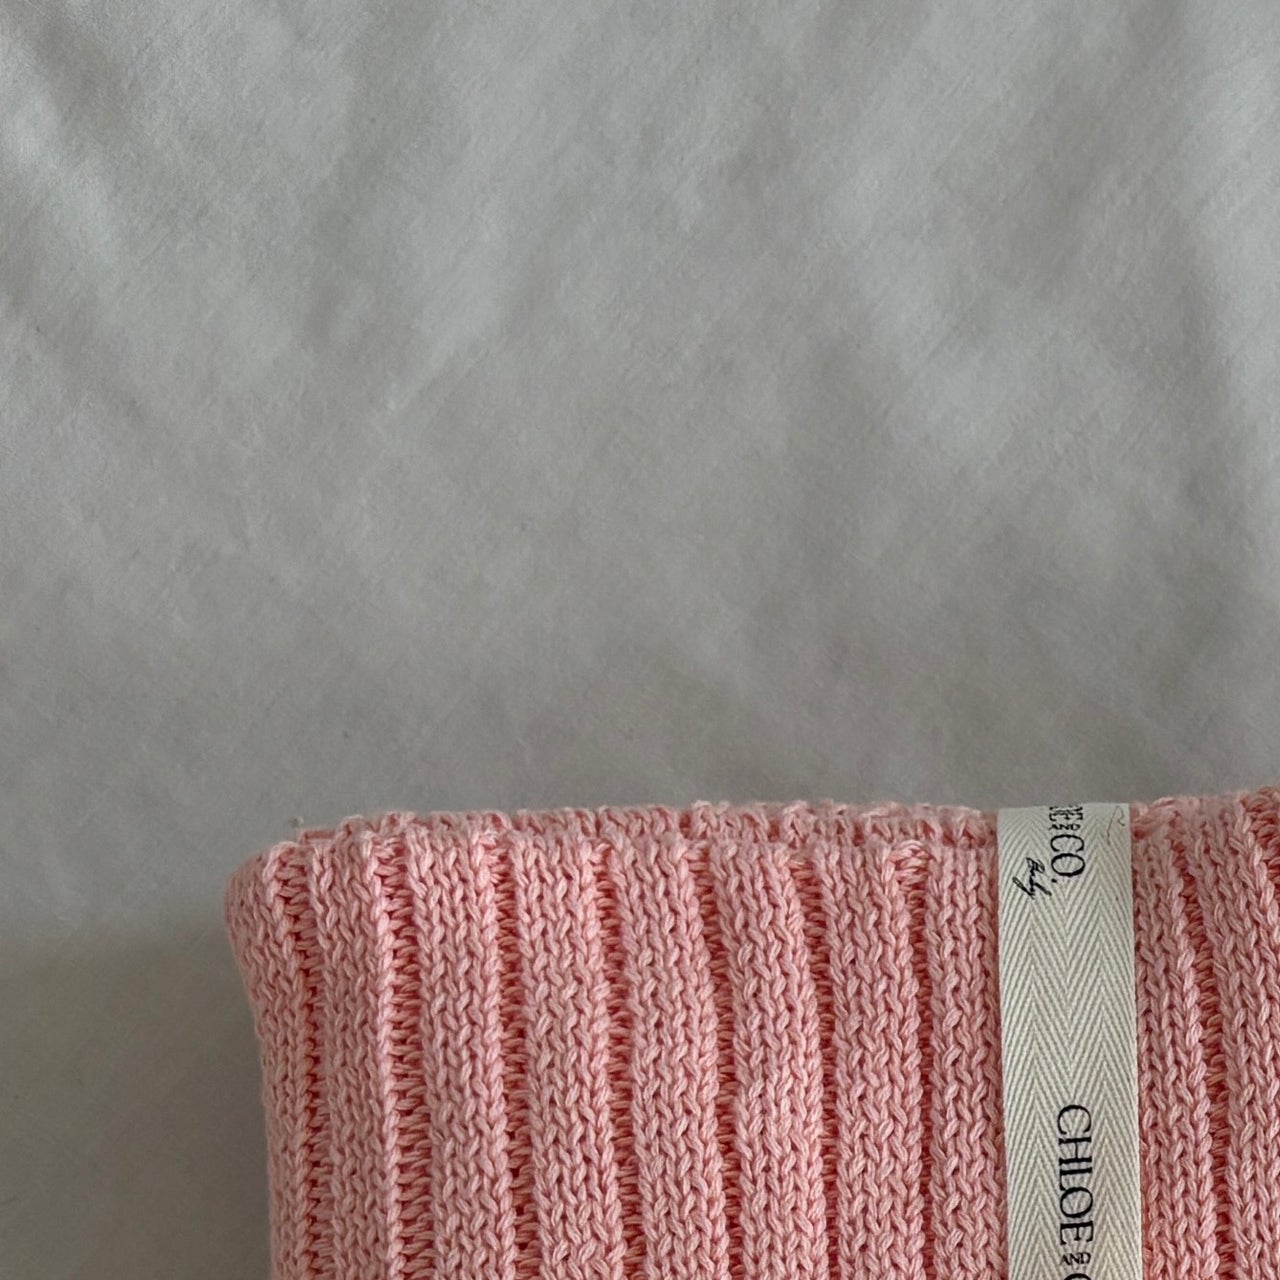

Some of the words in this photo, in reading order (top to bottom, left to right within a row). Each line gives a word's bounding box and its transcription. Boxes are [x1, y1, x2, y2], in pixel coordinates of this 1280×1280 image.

[1050, 834, 1085, 883] CO.
[1057, 1104, 1094, 1245] CHLOE
[1060, 1252, 1091, 1266] AND
